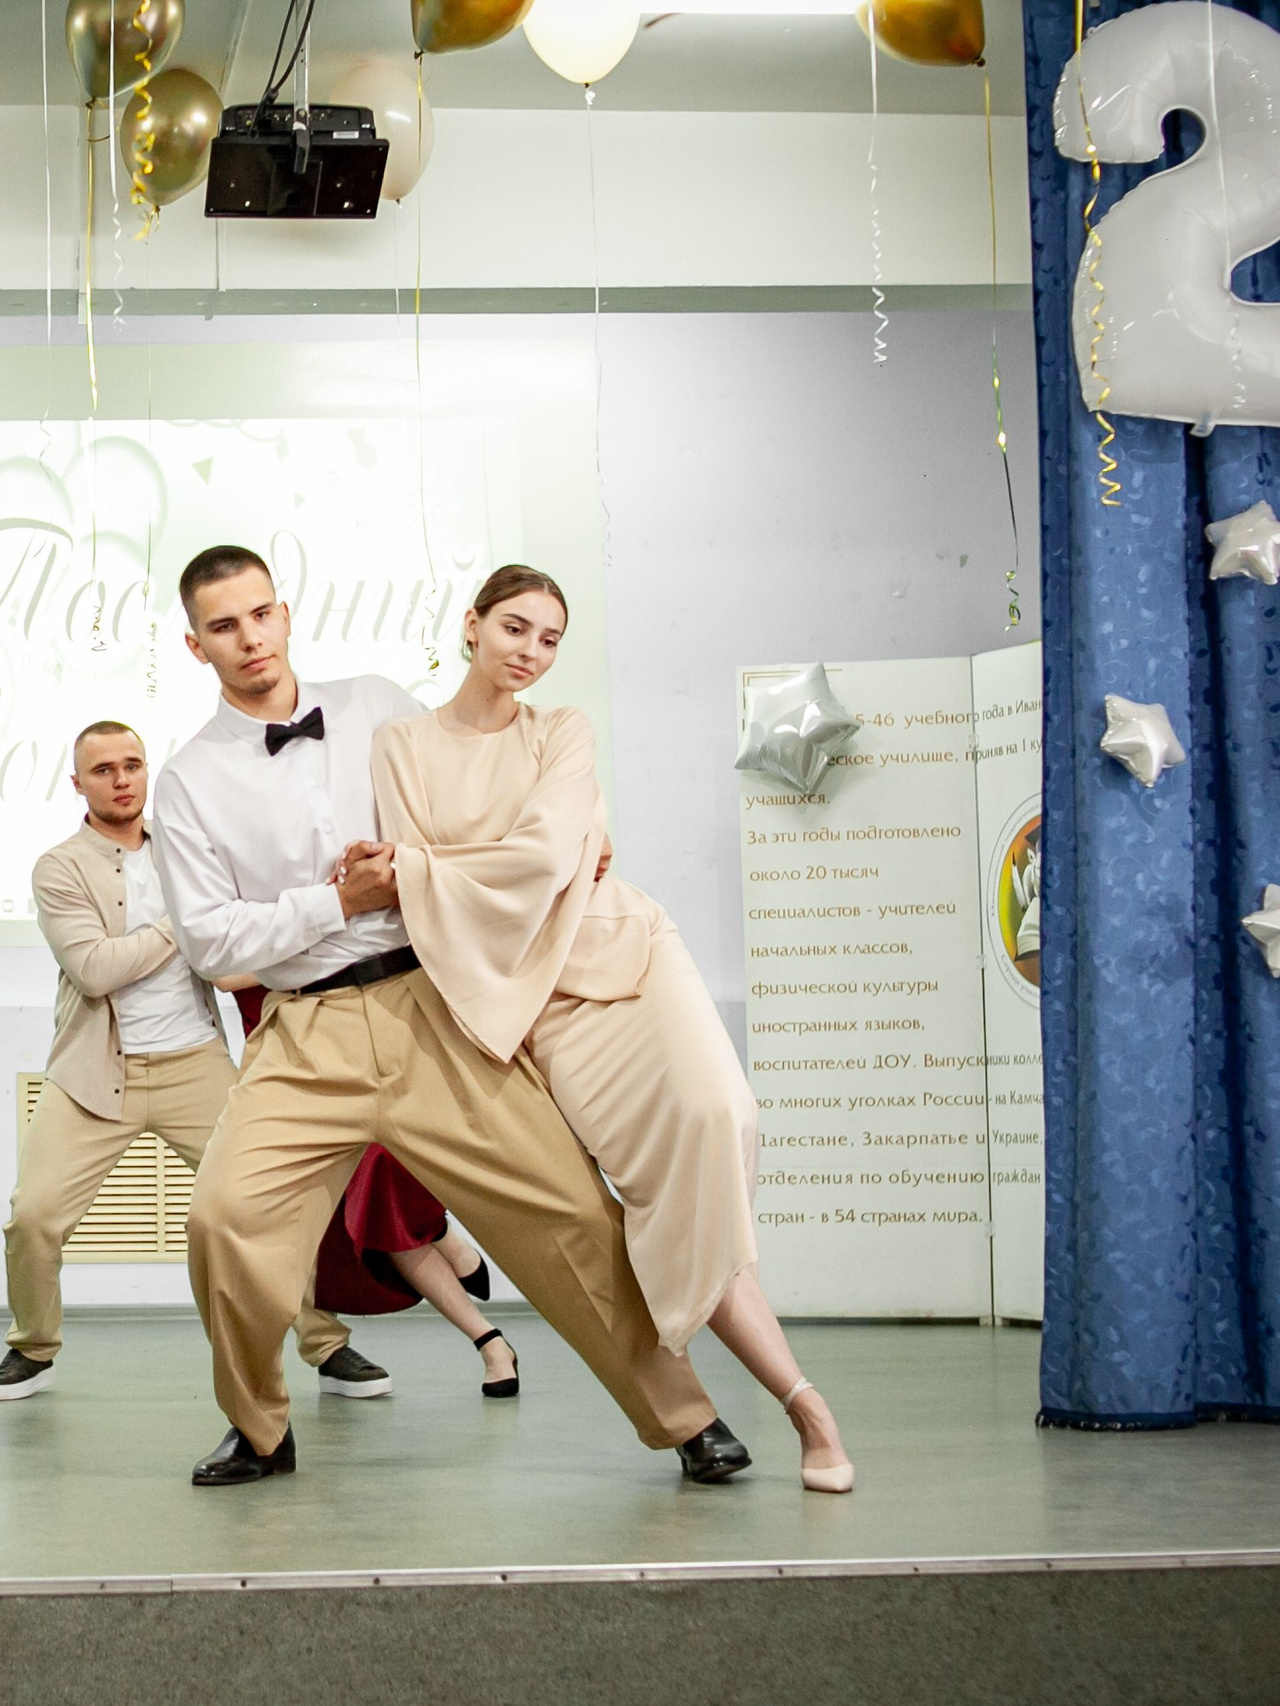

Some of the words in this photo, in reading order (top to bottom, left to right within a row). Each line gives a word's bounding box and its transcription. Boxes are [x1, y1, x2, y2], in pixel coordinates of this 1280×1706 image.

[904, 709, 980, 730] учебного
[982, 703, 1004, 721] года
[1007, 704, 1013, 716] в
[1006, 743, 1018, 755] на
[747, 830, 767, 845] За
[771, 831, 797, 843] эти
[802, 827, 841, 843] годы
[846, 825, 962, 842] подготовлено
[749, 869, 802, 882] около
[805, 865, 827, 880] 20
[830, 867, 880, 880] тысяч
[748, 906, 862, 920] специалистов
[877, 899, 957, 920] учителей
[750, 944, 838, 958] начальных
[842, 942, 914, 956] классов,
[751, 980, 858, 999] физической
[862, 980, 940, 996] культуры
[751, 1020, 858, 1036] иностранных
[864, 1018, 926, 1032] языков,
[753, 1056, 867, 1072] воспитателей
[923, 1053, 1011, 1071] Выпускники
[779, 1096, 843, 1108] многих
[847, 1095, 917, 1111] уголках
[923, 1092, 986, 1107] России
[862, 1131, 969, 1148] Закарпатье
[975, 1133, 986, 1145] и
[757, 1171, 853, 1185] отделения
[860, 1173, 882, 1184] по
[888, 1169, 985, 1188] обучению
[992, 1168, 1041, 1187] граждан
[758, 1212, 805, 1227] стран
[821, 1213, 830, 1223] в
[835, 1209, 856, 1223] 54
[860, 1211, 927, 1227] странах
[932, 1211, 984, 1224] мира.
